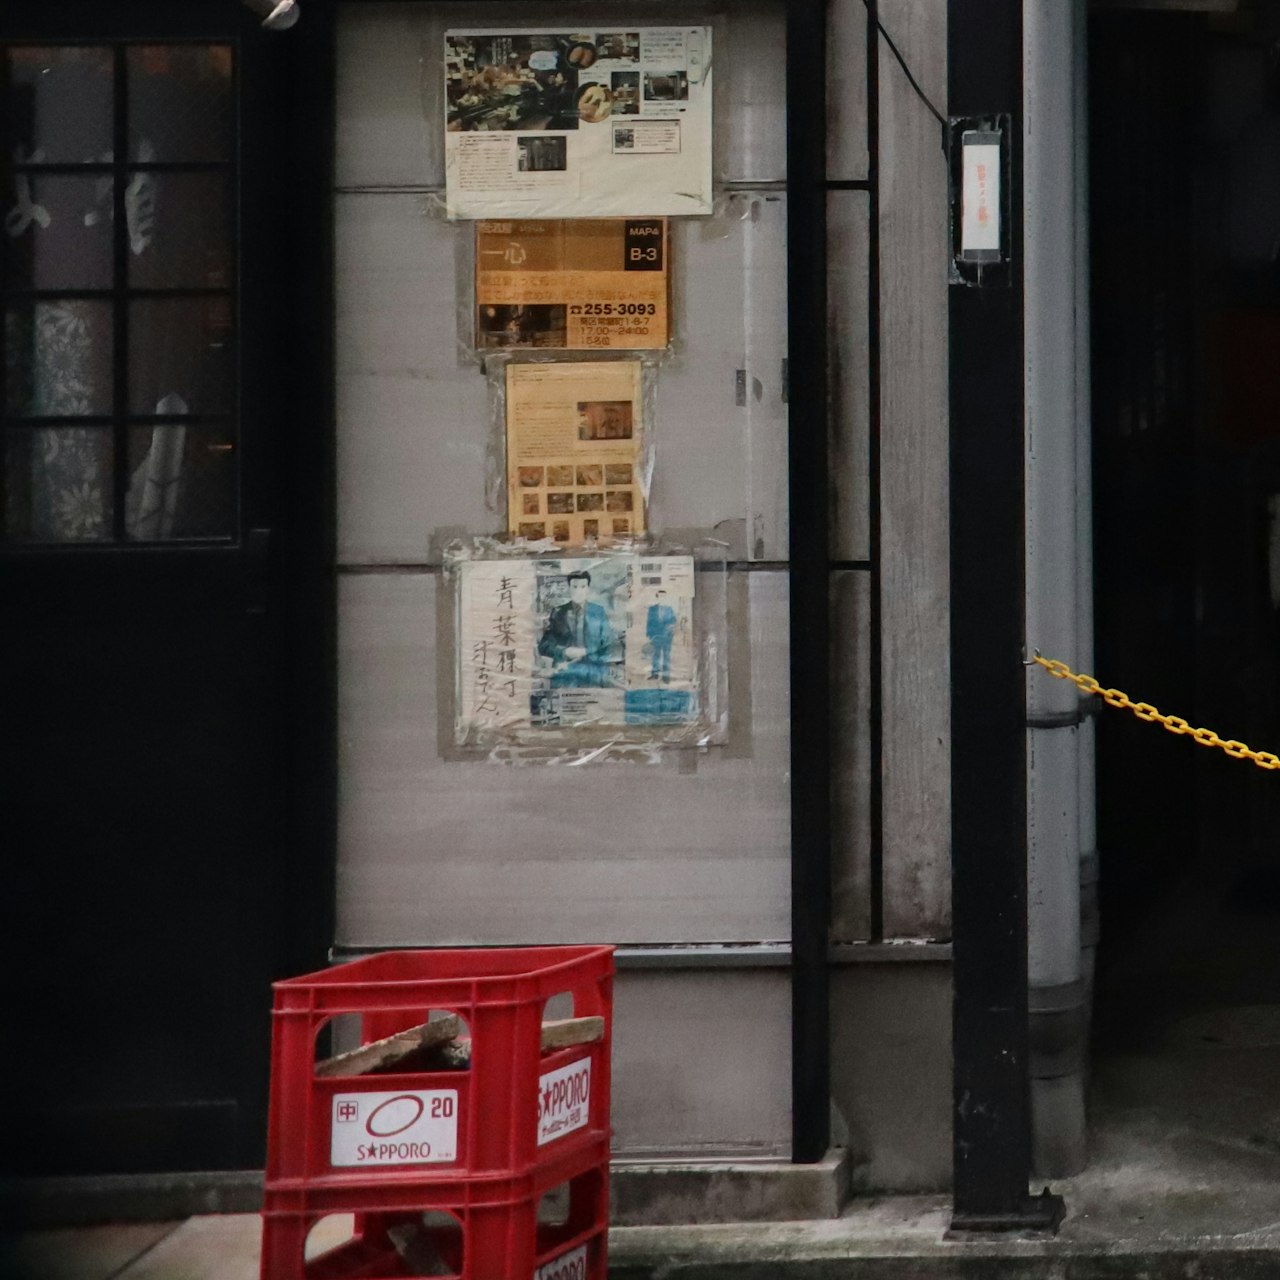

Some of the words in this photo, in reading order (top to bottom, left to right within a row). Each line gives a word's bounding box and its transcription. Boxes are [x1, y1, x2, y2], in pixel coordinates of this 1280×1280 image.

[629, 247, 658, 262] B-3
[584, 302, 656, 316] 255-3093
[339, 1103, 356, 1120] 中
[431, 1097, 453, 1118] 20
